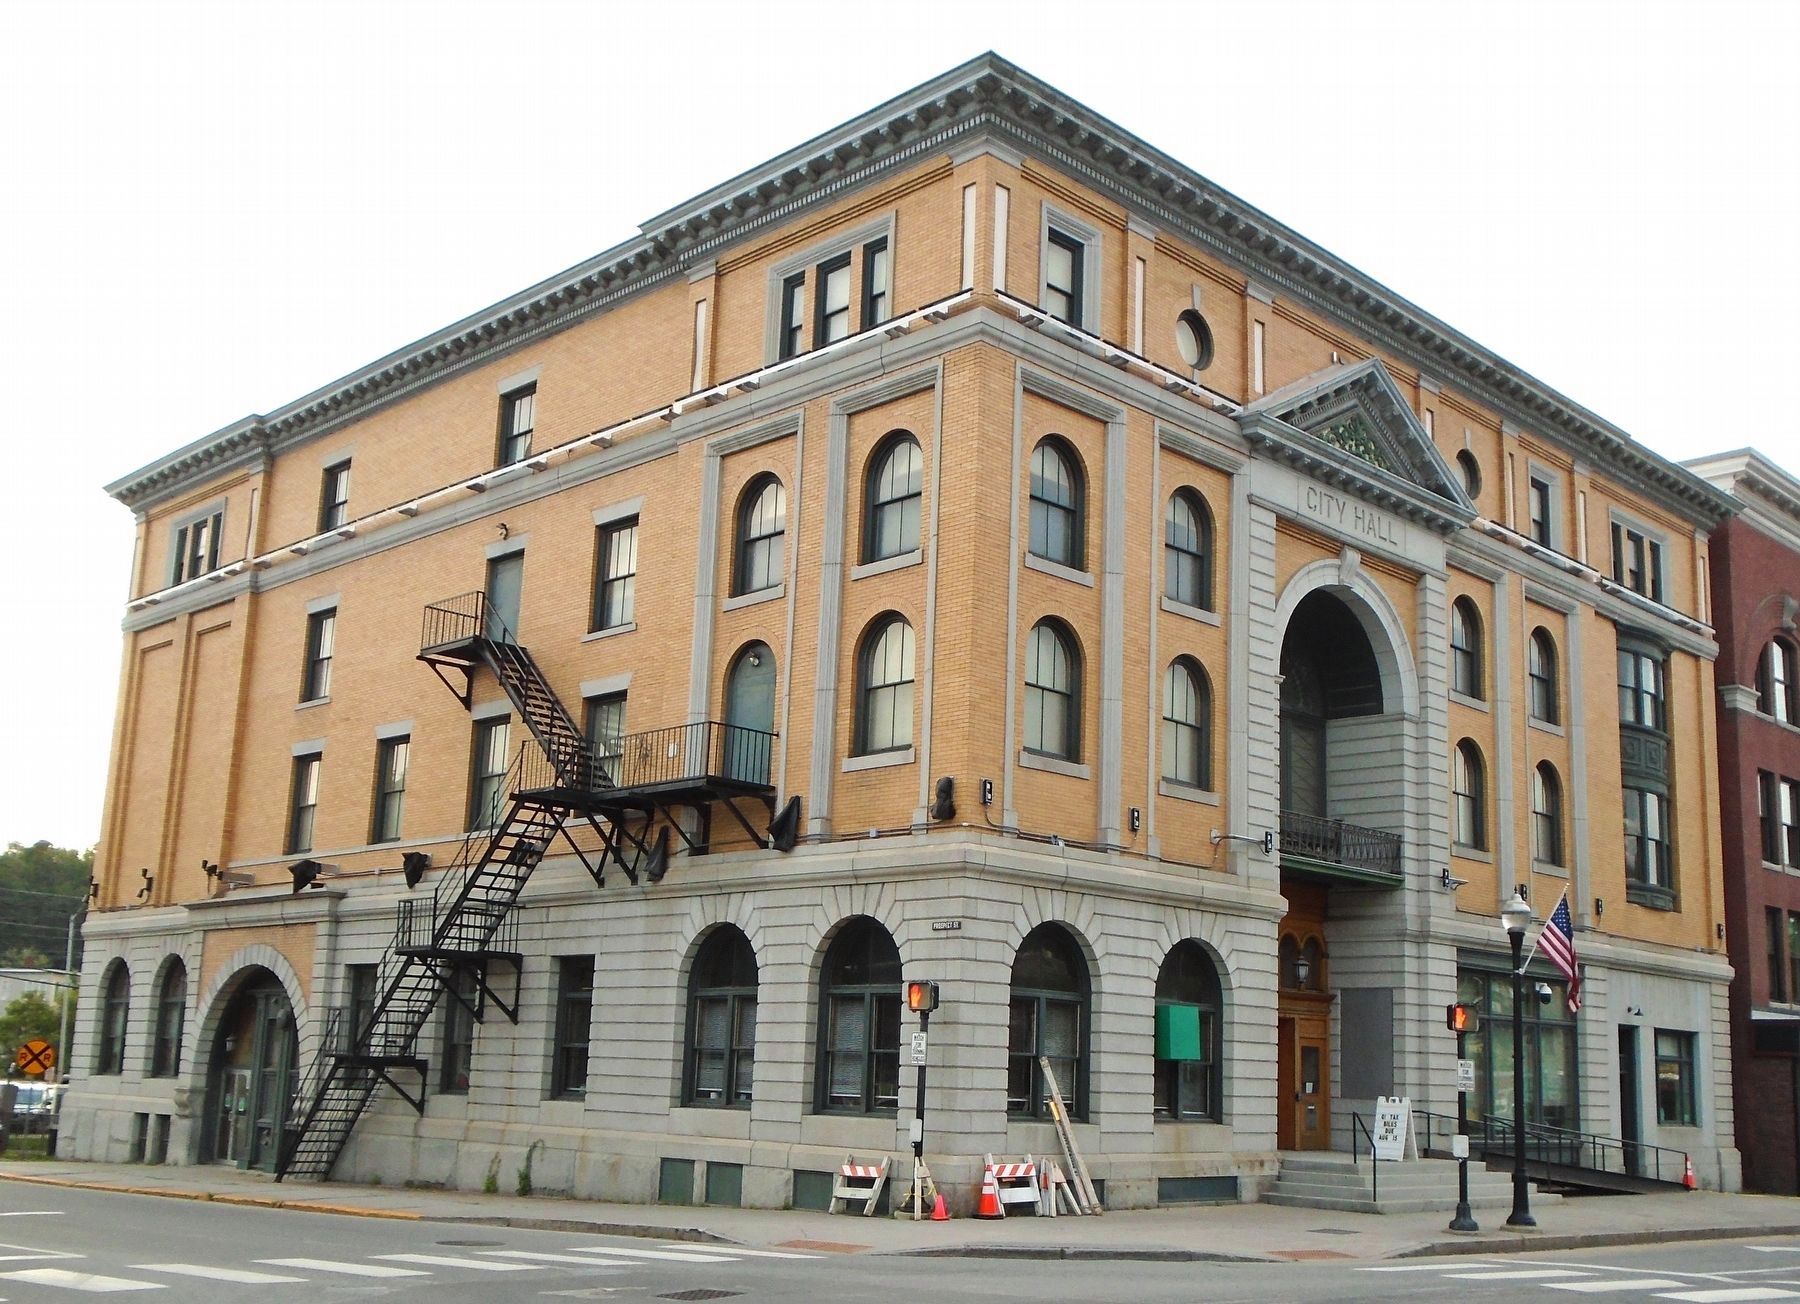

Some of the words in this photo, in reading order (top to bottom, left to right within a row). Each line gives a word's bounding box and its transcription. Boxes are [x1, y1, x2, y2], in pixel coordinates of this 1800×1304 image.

[1306, 486, 1346, 524] CITY
[1354, 505, 1398, 546] HALL
[933, 921, 953, 929] PROSPECT
[20, 1052, 28, 1062] R
[44, 1053, 51, 1062] R
